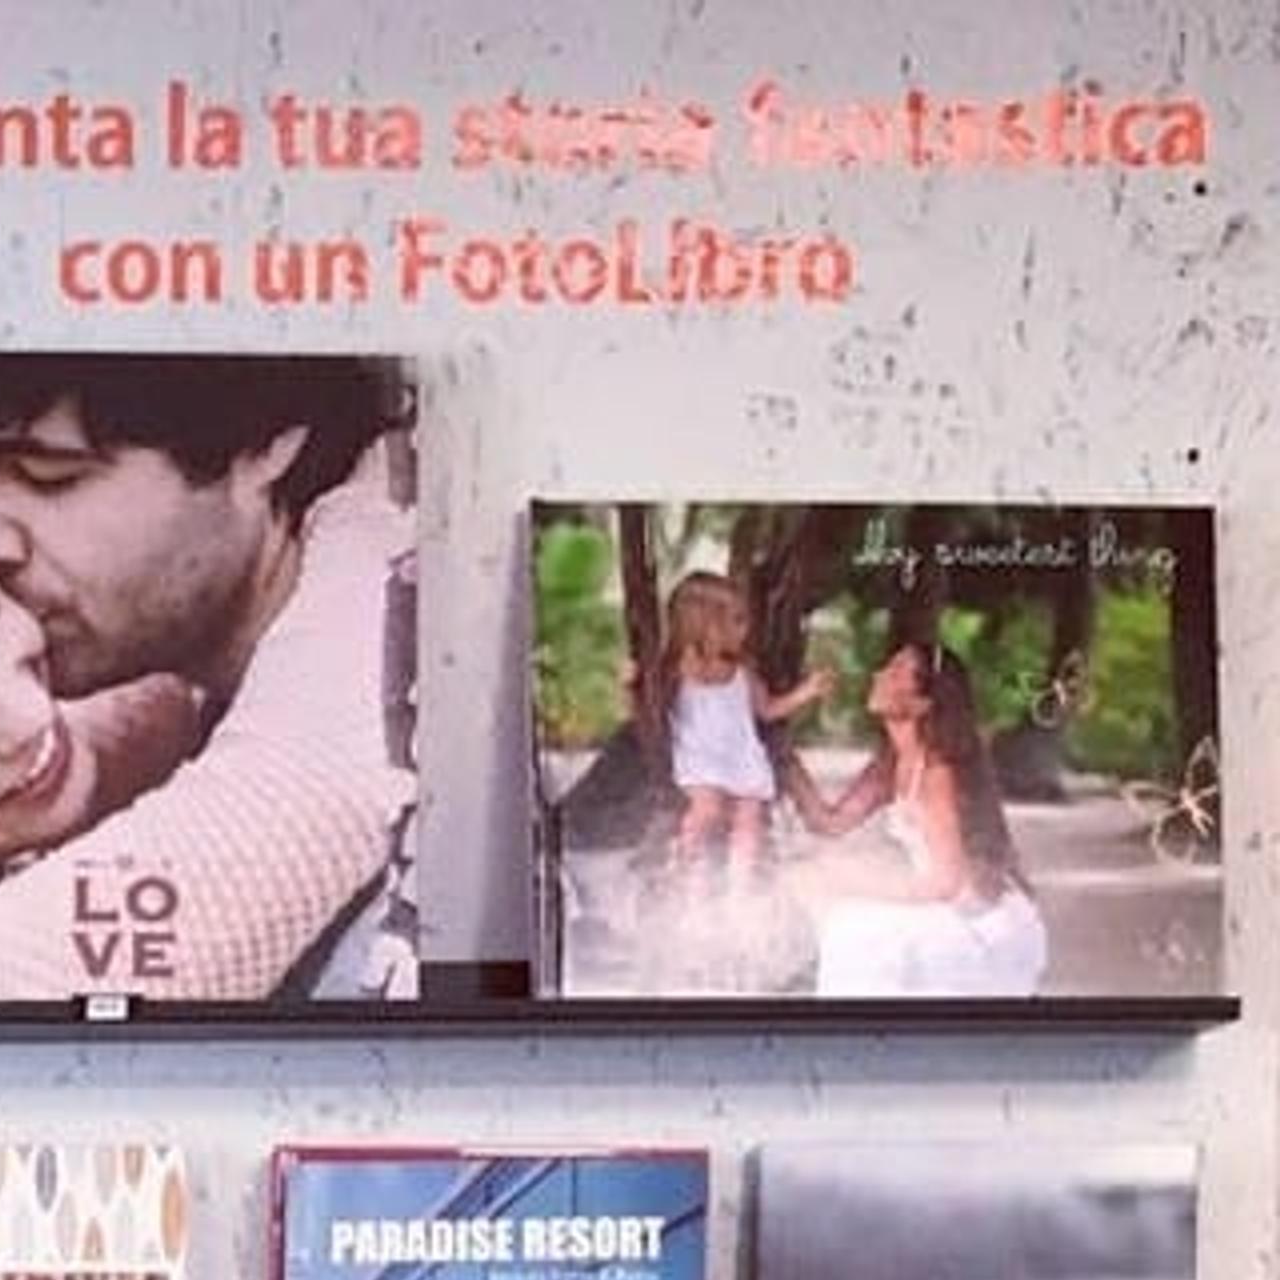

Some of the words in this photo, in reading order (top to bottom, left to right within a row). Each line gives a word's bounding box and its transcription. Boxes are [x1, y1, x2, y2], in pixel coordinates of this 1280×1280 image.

[166, 80, 241, 169] la
[268, 92, 424, 170] tua
[744, 78, 1208, 168] fantastica
[57, 238, 222, 302] con
[253, 238, 370, 302] un
[393, 216, 854, 305] FotoLibro
[74, 875, 179, 923] LO
[71, 932, 177, 979] VE
[330, 1215, 514, 1263] PARADISE
[522, 1214, 666, 1261] RESORT
